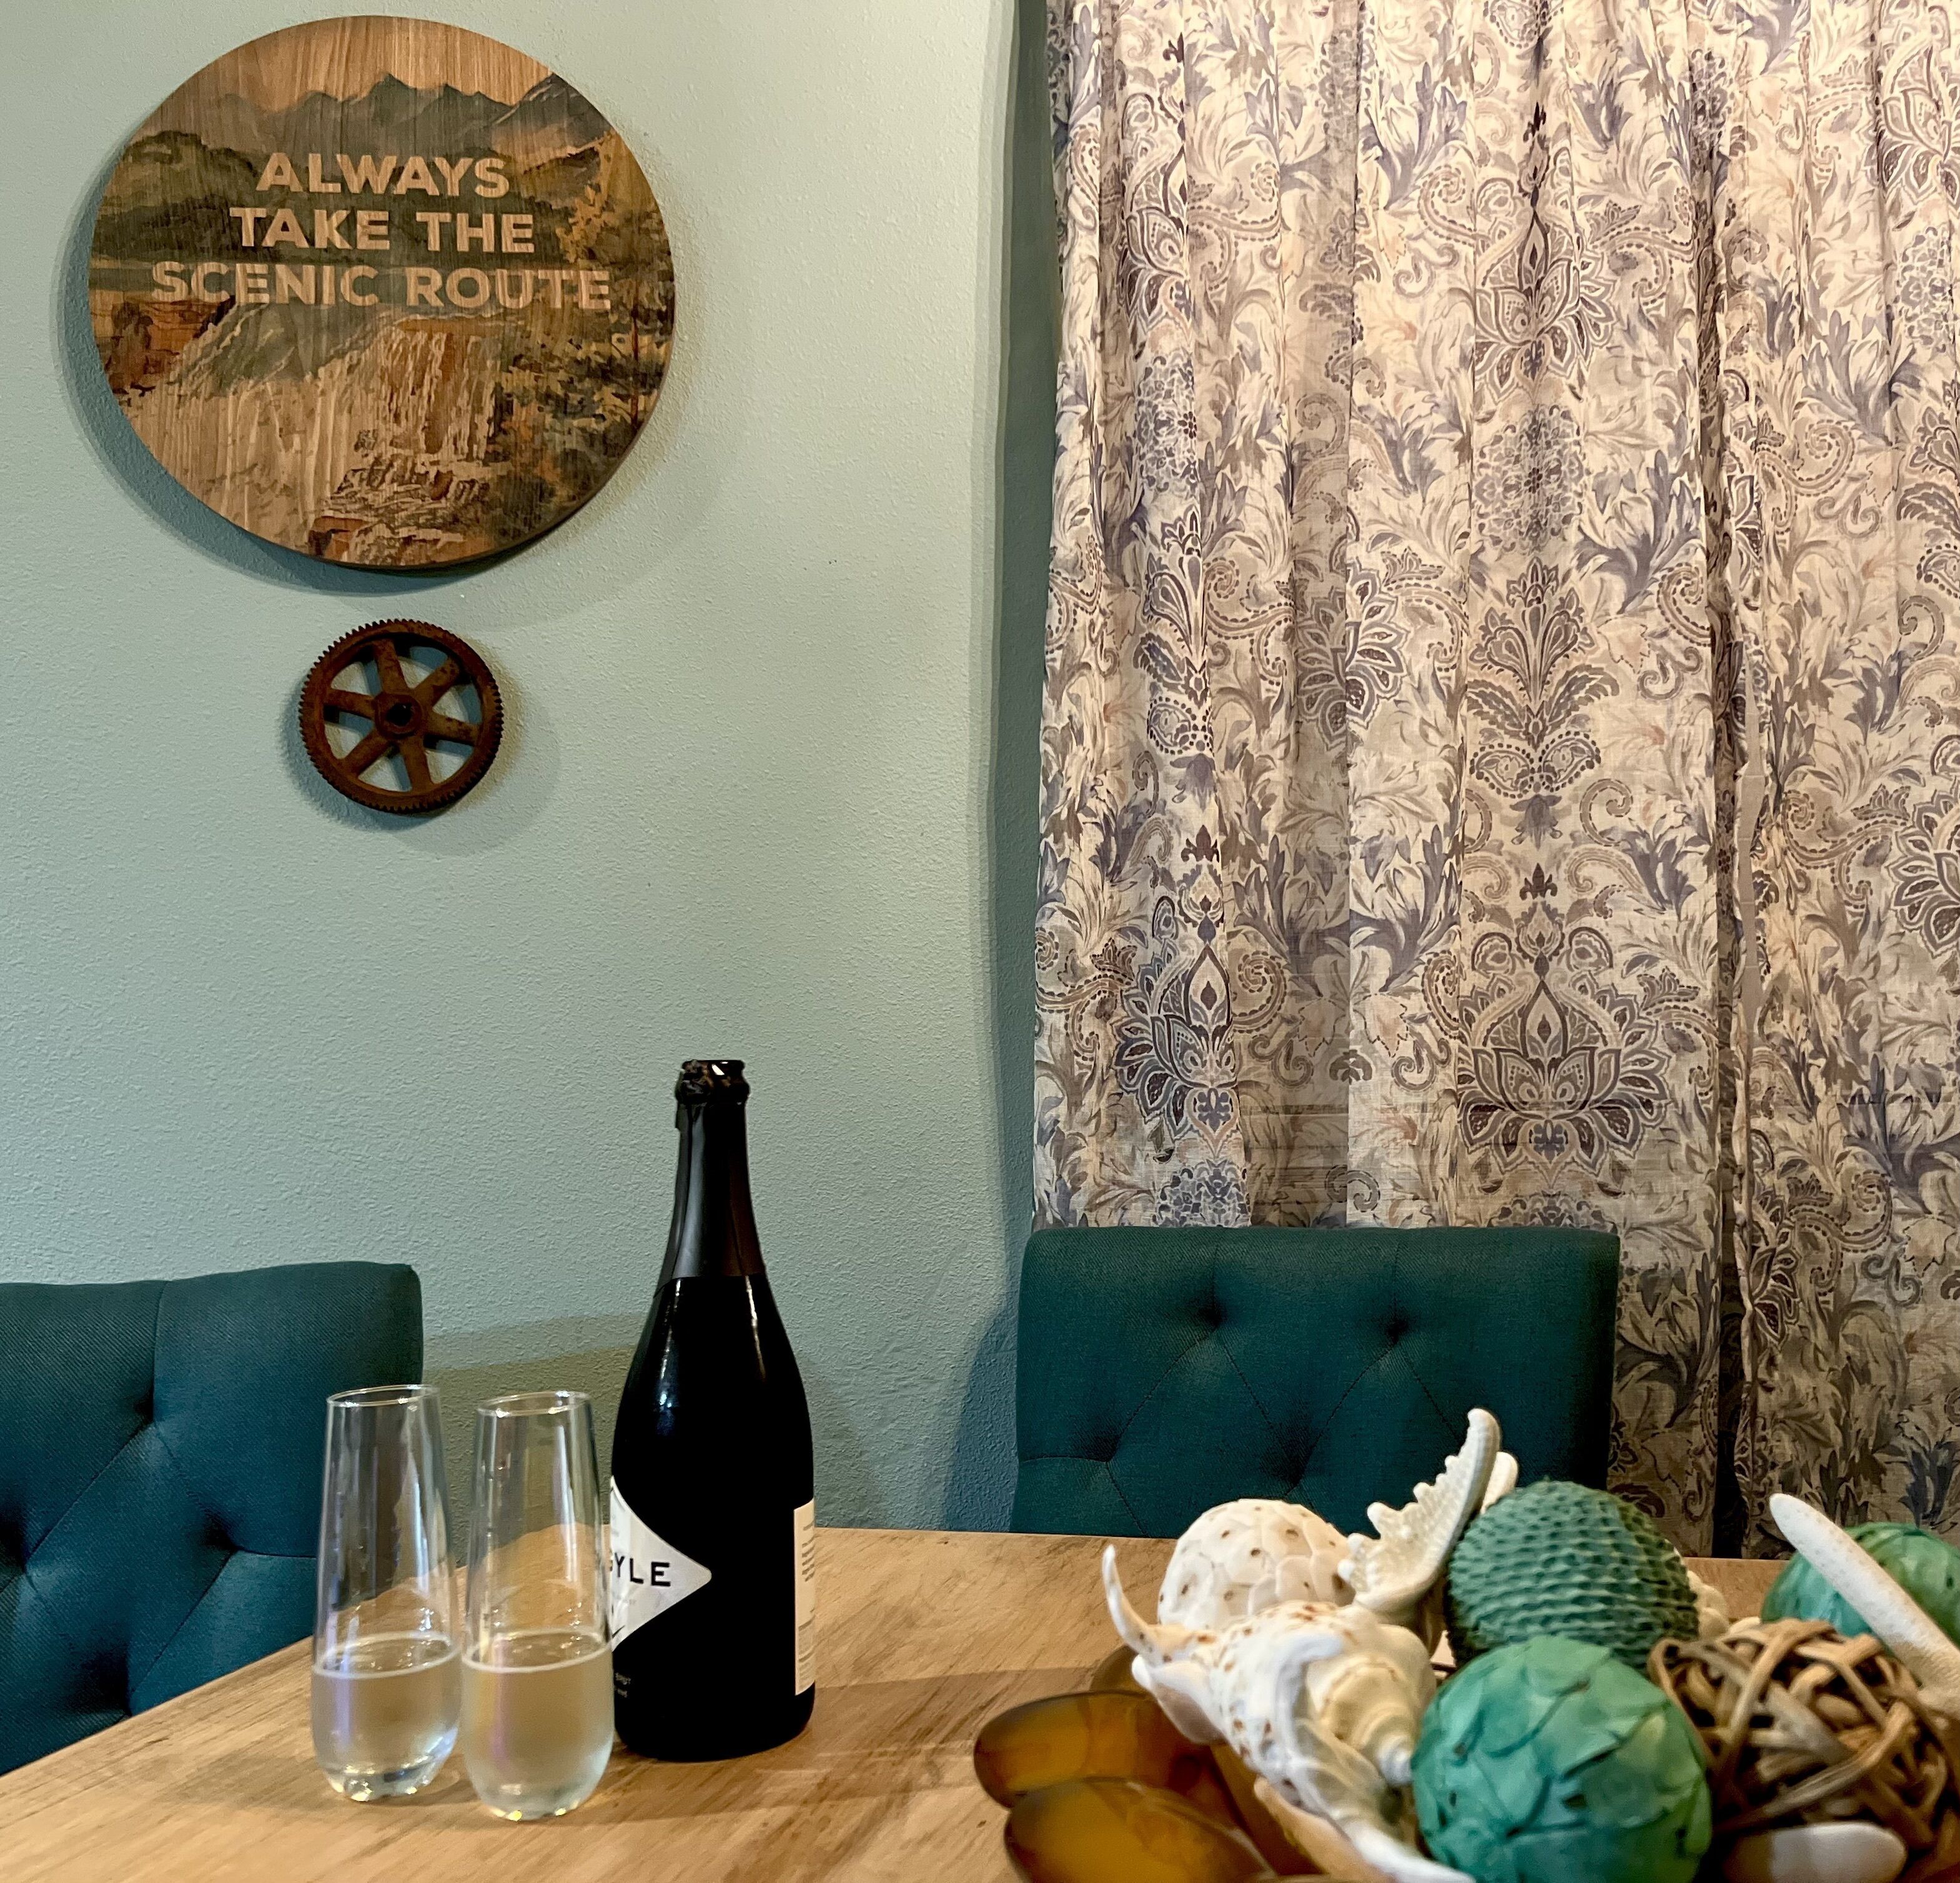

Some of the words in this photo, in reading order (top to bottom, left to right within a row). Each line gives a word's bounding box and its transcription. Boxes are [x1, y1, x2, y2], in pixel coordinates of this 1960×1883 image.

[255, 152, 510, 199] ALWAYS
[229, 207, 390, 249] TAKE
[416, 211, 535, 253] THE
[151, 261, 379, 306] SCENIC
[405, 267, 611, 310] ROUTE
[610, 1552, 671, 1587] YLE
